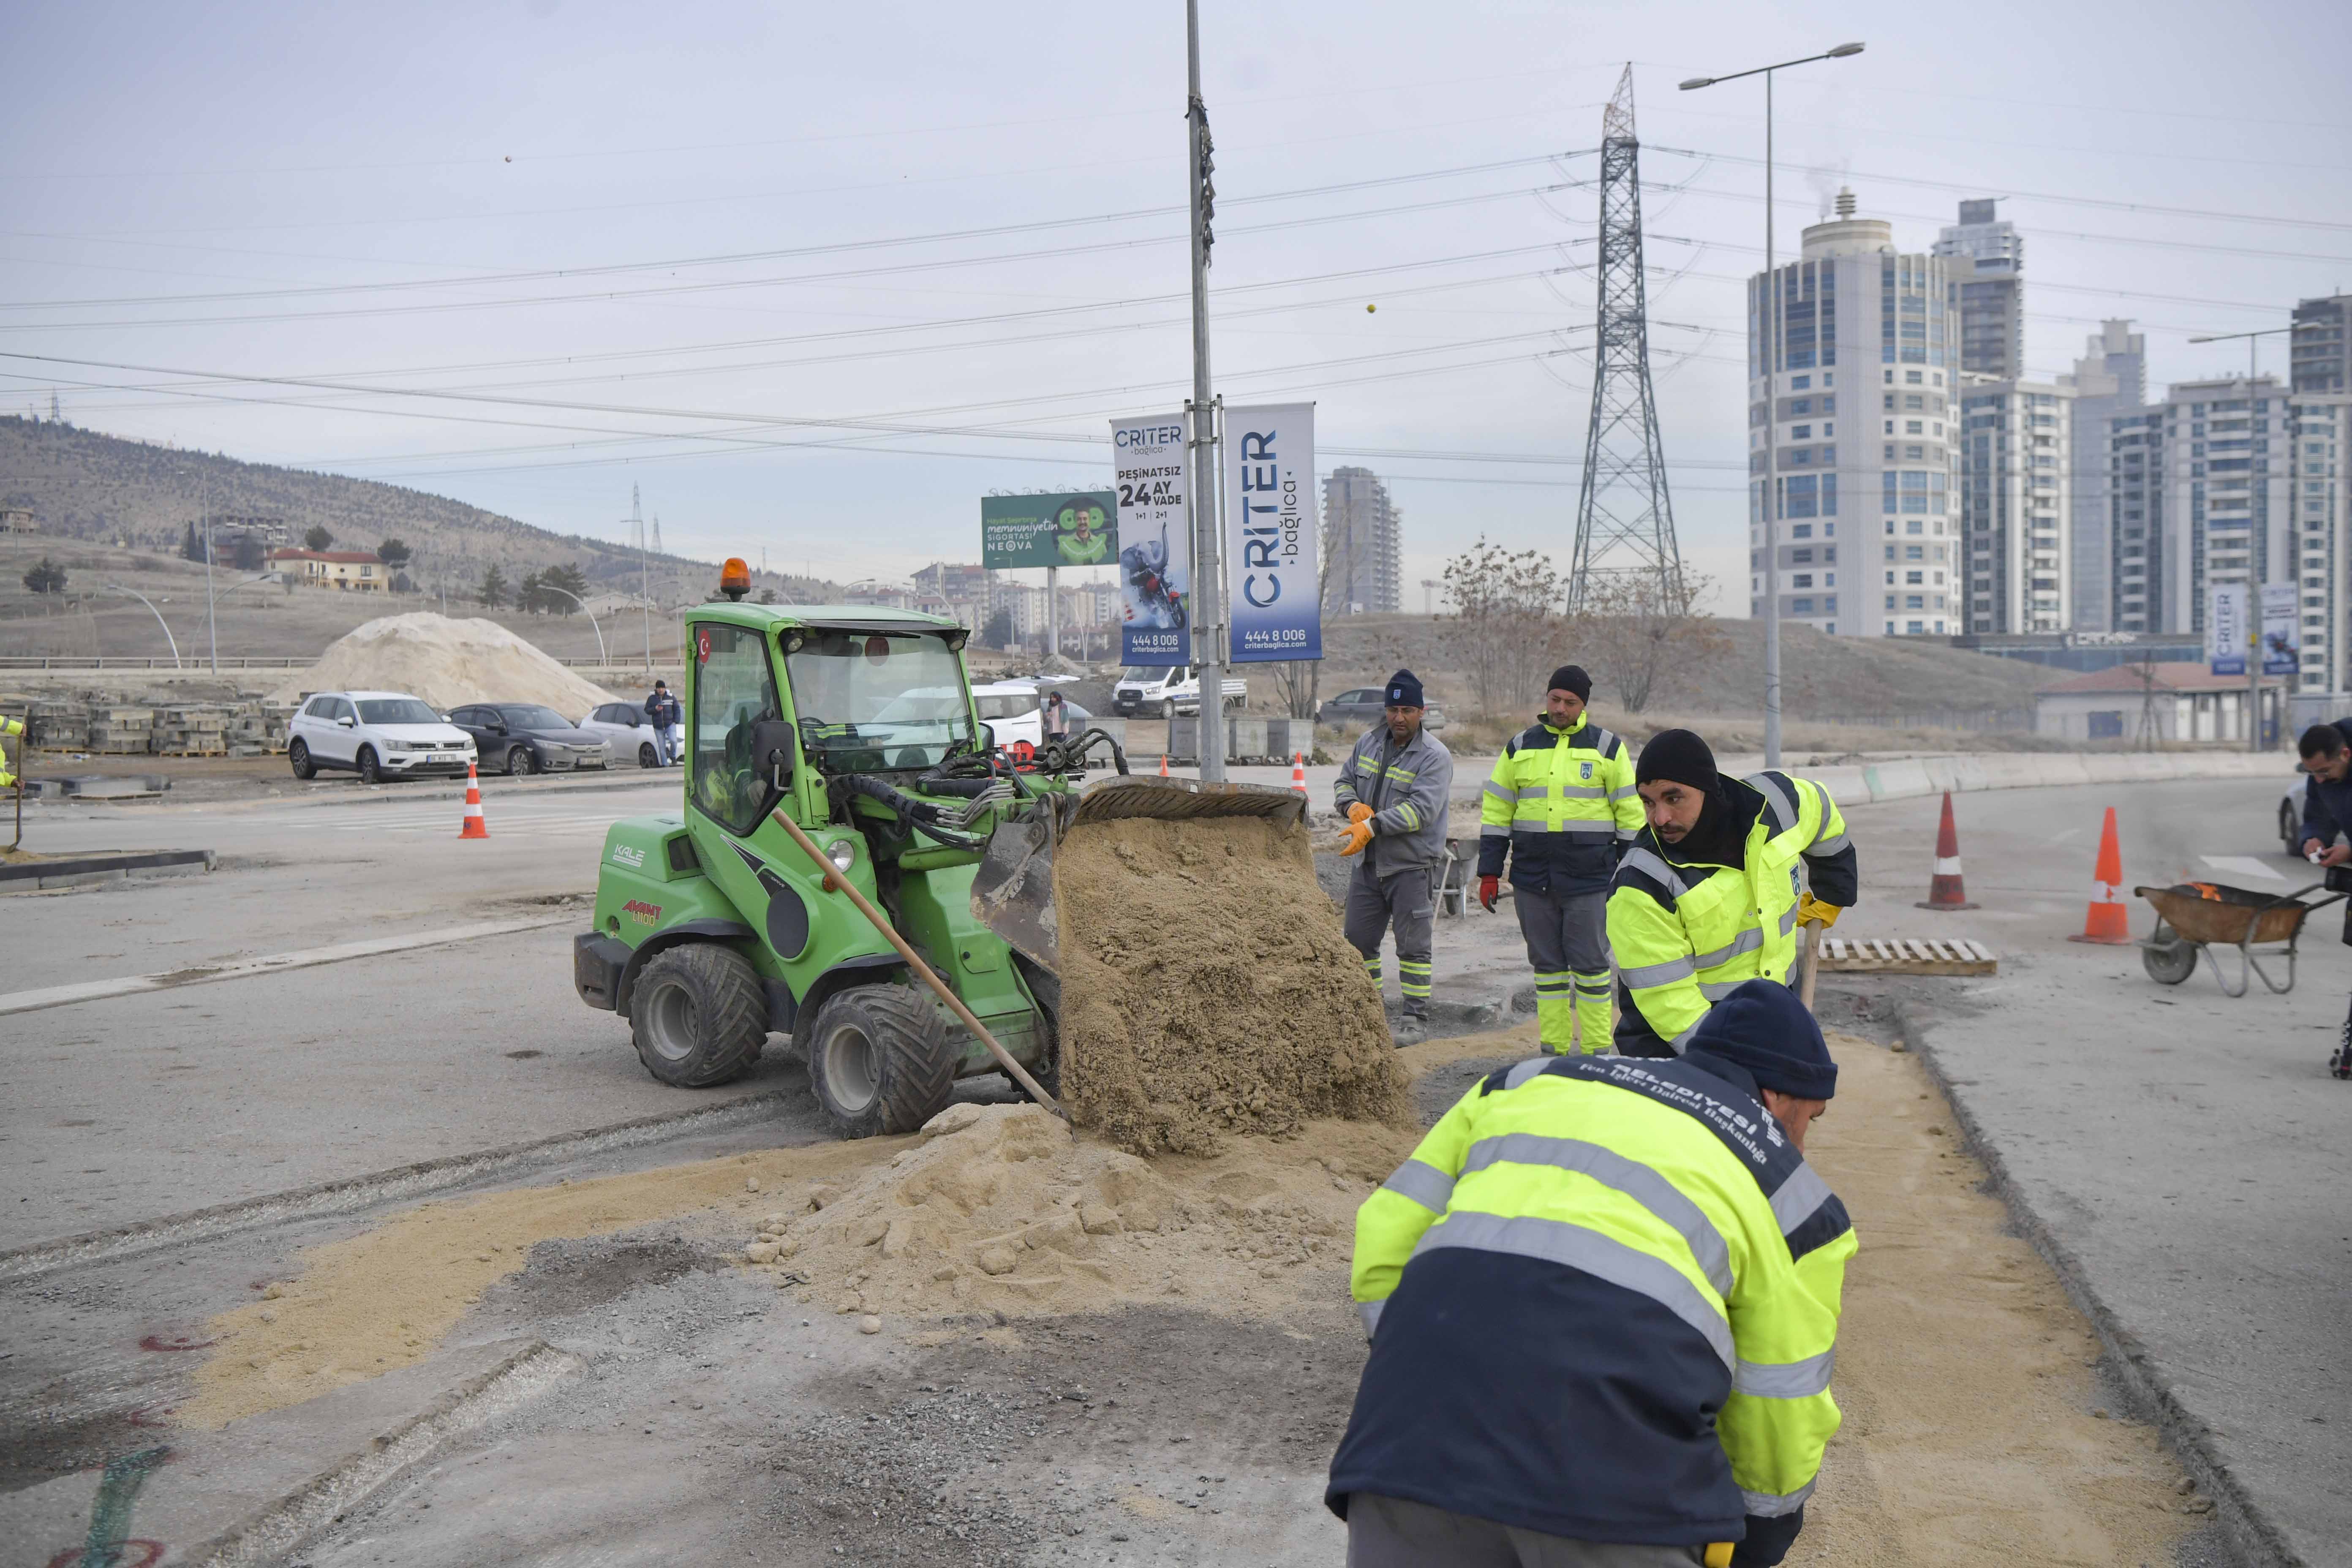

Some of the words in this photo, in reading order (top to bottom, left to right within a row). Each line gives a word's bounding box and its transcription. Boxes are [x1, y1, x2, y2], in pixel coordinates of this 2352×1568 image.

[1119, 483, 1151, 507] 24
[1153, 481, 1172, 495] AY
[1153, 495, 1181, 506] VADE
[988, 518, 1058, 536] memnuniyetin
[1132, 635, 1150, 645] 444
[1152, 635, 1158, 645] 8
[1160, 635, 1178, 645] 006
[1245, 631, 1269, 642] 444
[1272, 630, 1279, 641] 8
[1282, 629, 1306, 641] 006
[1132, 646, 1179, 654] criterbaglica.com
[1244, 641, 1307, 650] criterbaglica.com
[615, 844, 645, 861] KALE
[621, 899, 662, 920] AVANT
[632, 911, 655, 926] L1100
